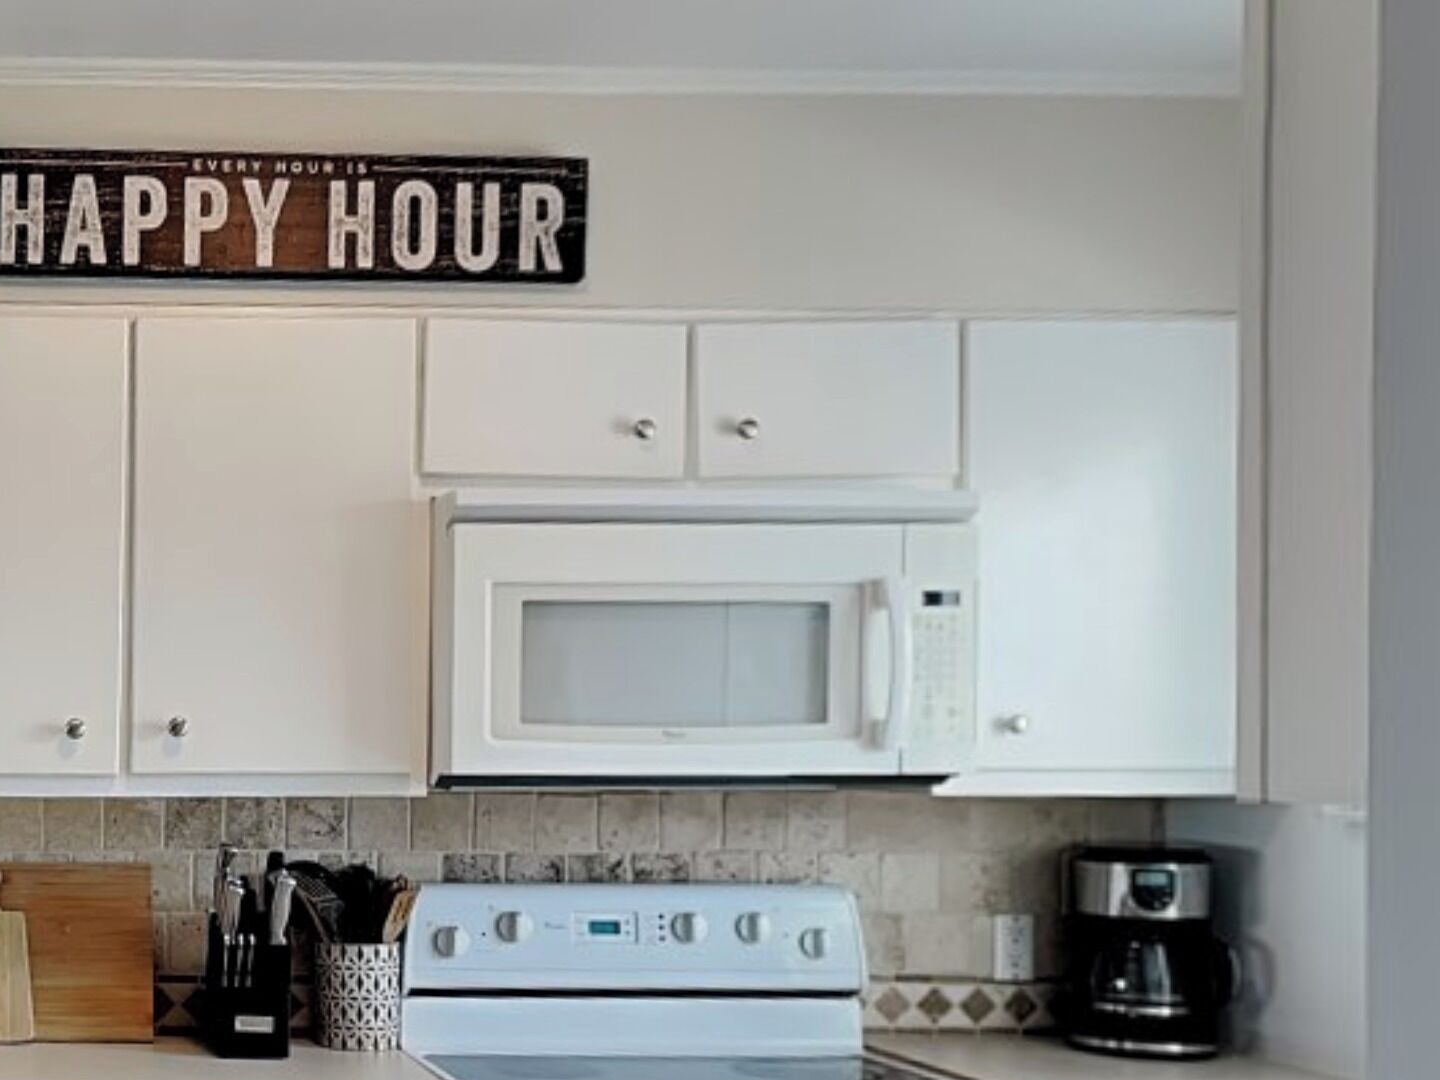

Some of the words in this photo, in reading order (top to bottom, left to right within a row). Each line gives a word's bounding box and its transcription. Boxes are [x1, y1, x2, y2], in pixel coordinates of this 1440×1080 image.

[192, 158, 261, 172] EVERY
[274, 160, 335, 174] HOUR
[346, 160, 368, 174] IS
[327, 179, 565, 272] HOUR
